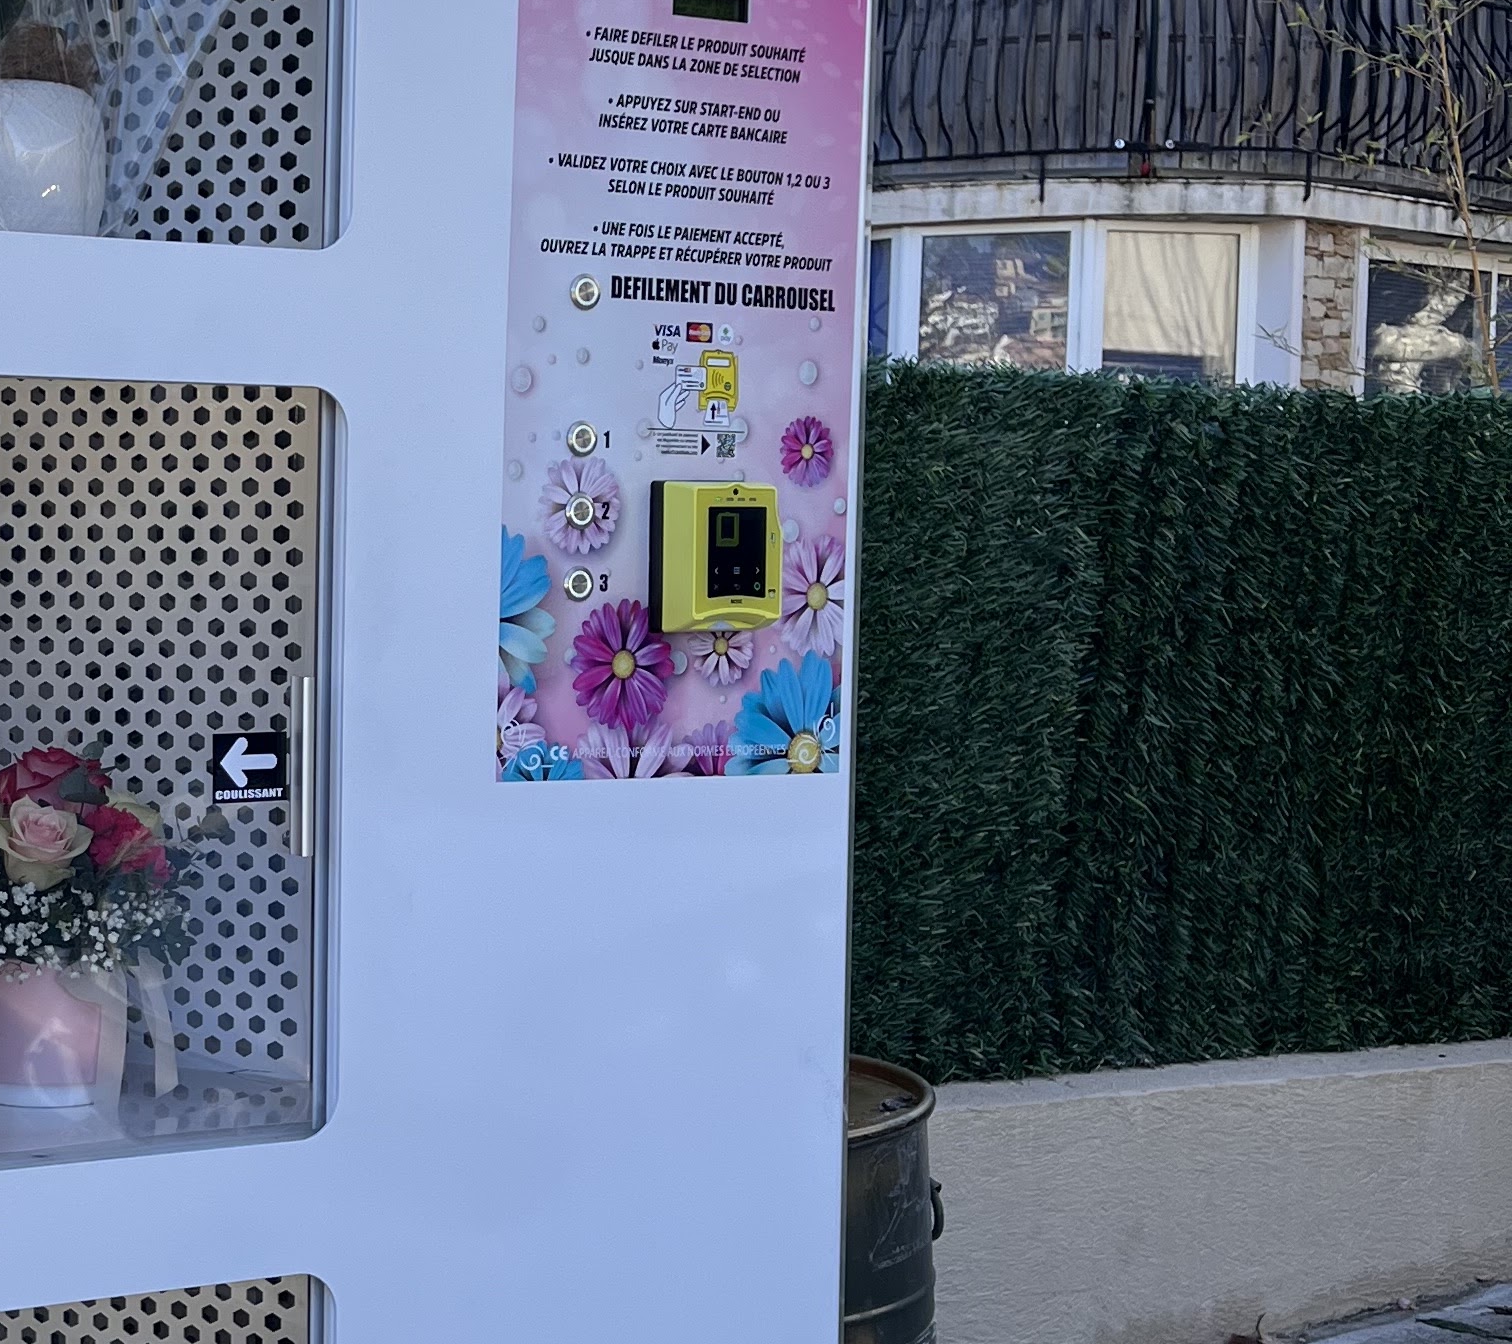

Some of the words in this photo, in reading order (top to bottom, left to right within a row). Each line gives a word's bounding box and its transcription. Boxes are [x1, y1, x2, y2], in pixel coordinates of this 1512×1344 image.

[594, 27, 629, 43] FAIRE
[631, 31, 678, 49] DEFILER
[681, 36, 695, 51] LE
[697, 38, 748, 57] PRODUIT
[750, 44, 807, 63] SOUHAITÉ
[589, 48, 635, 66] JUSQUE
[638, 53, 669, 70] DANS
[672, 58, 687, 71] LA
[690, 58, 721, 74] ZONE
[723, 62, 738, 77] DE
[741, 64, 801, 84] SELECTION
[616, 94, 672, 112] APPUYEZ
[674, 99, 697, 115] SUR
[699, 101, 761, 121] START-END
[764, 108, 781, 122] OU
[599, 113, 648, 131] INSÉREZ
[651, 118, 689, 135] VOTRE
[691, 122, 728, 138] CARTE
[730, 127, 788, 144] BANCAIRE
[558, 153, 607, 170] VALIDEZ
[610, 157, 648, 174] VOTRE
[651, 161, 687, 177] CHOIX
[688, 164, 718, 180] AVEC
[720, 167, 734, 181] LE
[736, 169, 783, 186] BOUTON
[787, 173, 803, 189] 1,2
[805, 175, 821, 189] OU
[823, 176, 831, 190] 3
[608, 179, 646, 195] SELON
[648, 182, 662, 196] LE
[665, 184, 716, 201] PRODUIT
[718, 188, 775, 205] SOUHAITÉ
[601, 221, 626, 236] UNE
[628, 223, 655, 238] FOIS
[657, 225, 672, 239] LE
[674, 227, 732, 244] PAIEMENT
[733, 231, 785, 249] ACCEPTÉ,
[540, 238, 589, 255] OUVREZ
[592, 242, 606, 256] LA
[611, 243, 657, 259] TRAPPE
[659, 247, 673, 261] ET
[675, 246, 742, 265] RÉCUPÉRER
[745, 253, 782, 268] VOTRE
[783, 256, 833, 272] PRODUIT
[611, 275, 711, 304] DEFILEMENT
[715, 282, 737, 306] DU
[742, 284, 835, 312] CARROUSEL
[654, 325, 681, 337] VISA
[661, 339, 678, 354] Pay
[603, 430, 610, 448] 1
[601, 502, 610, 520] 2
[599, 574, 609, 592] 3
[550, 745, 568, 760] CE
[688, 744, 724, 757] NORMES
[215, 787, 284, 800] COULISSANT
